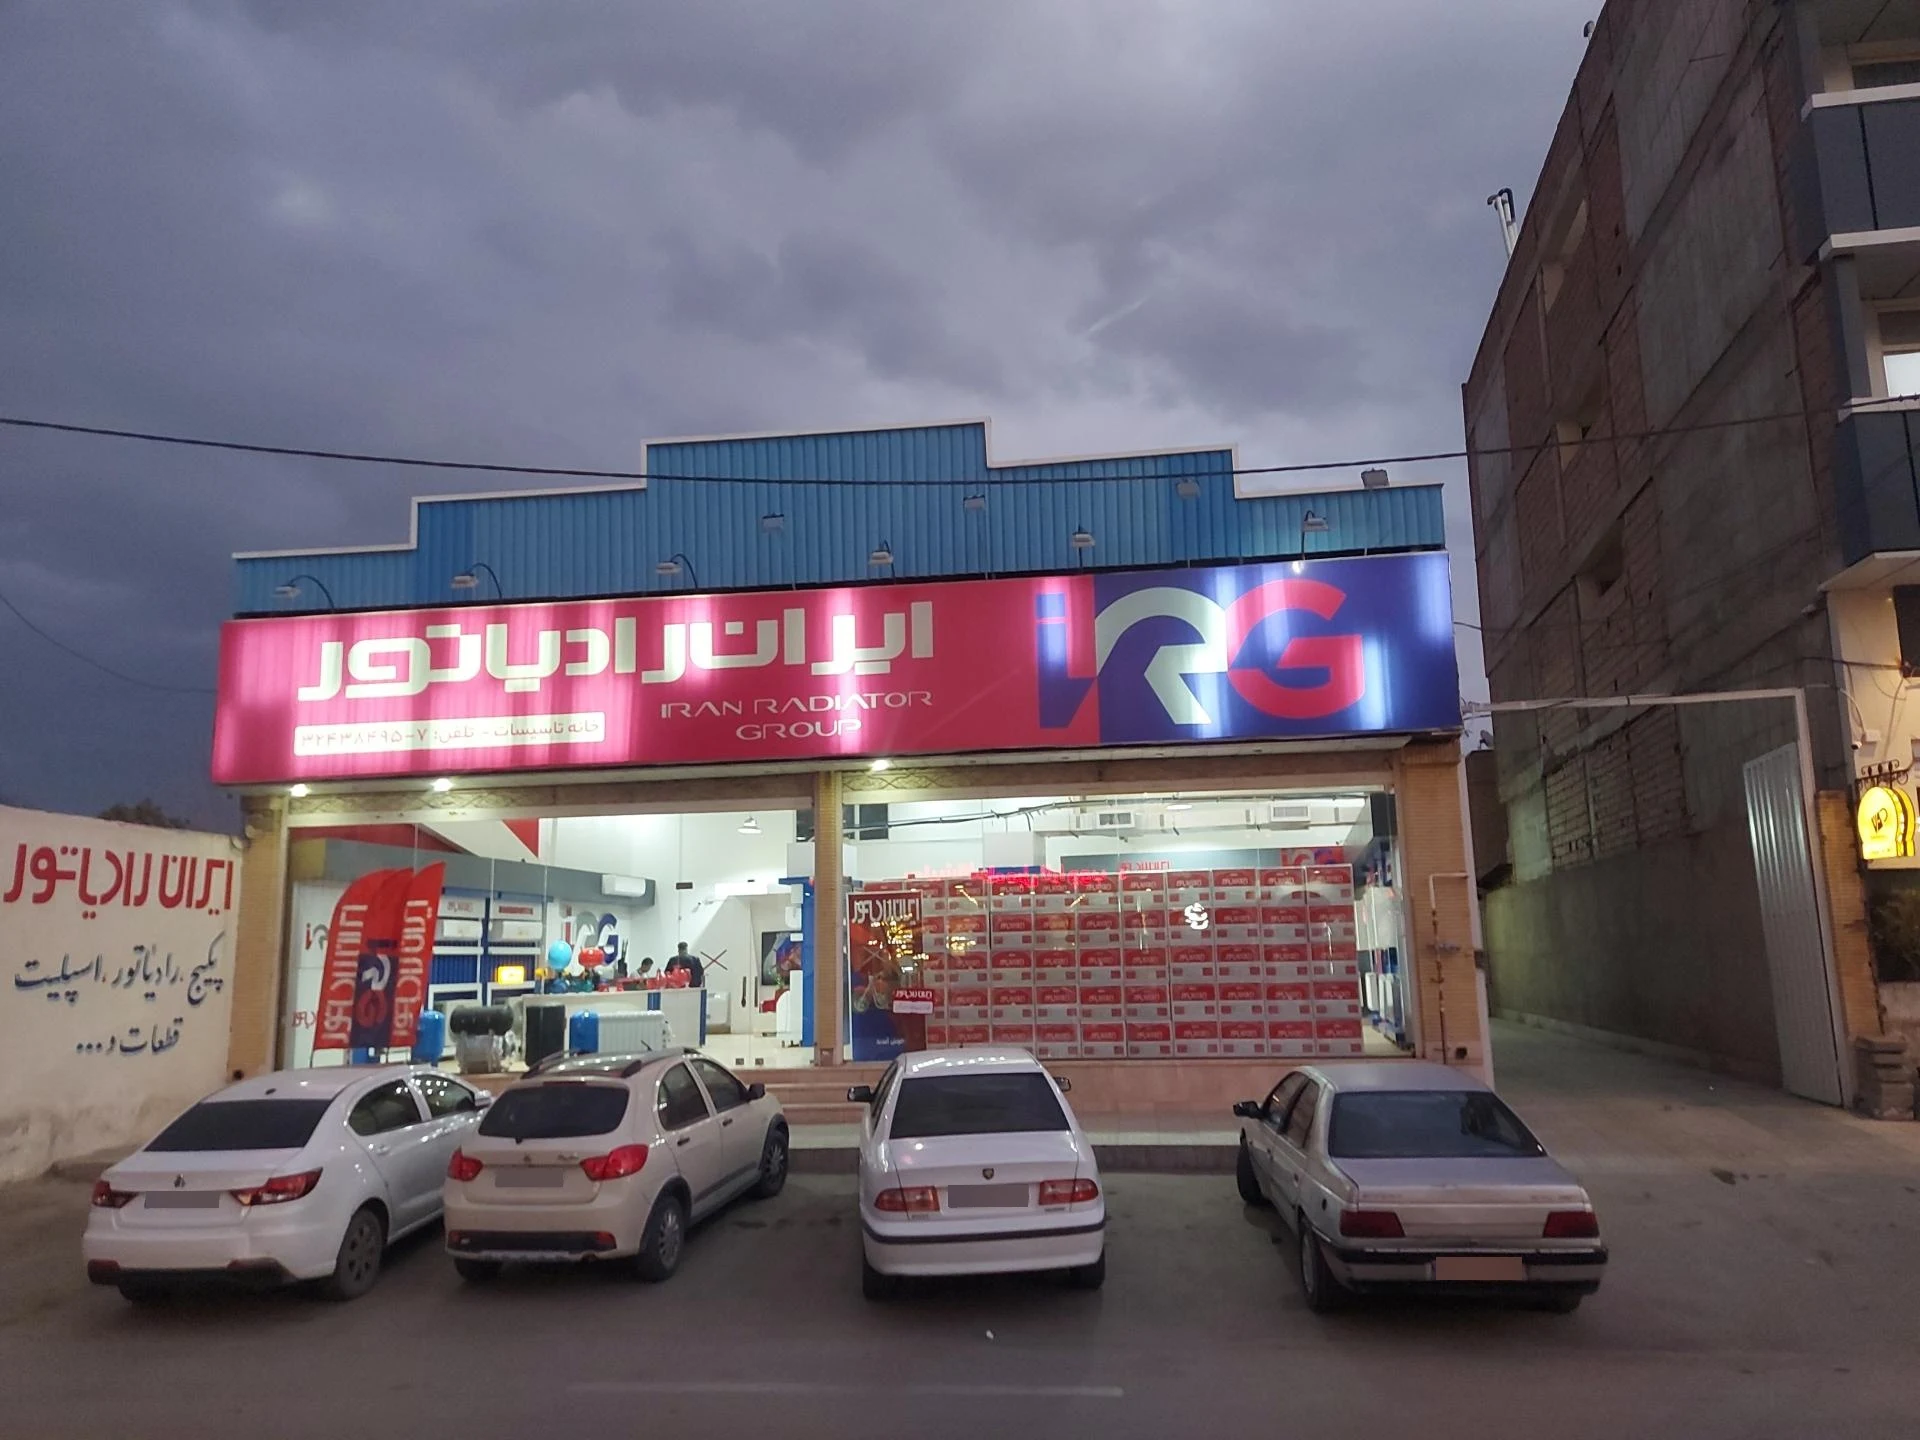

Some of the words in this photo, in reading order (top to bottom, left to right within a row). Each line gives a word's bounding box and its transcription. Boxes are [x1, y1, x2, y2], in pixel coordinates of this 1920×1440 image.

[687, 601, 934, 677] ایران
[297, 616, 687, 702] رادیاتور
[661, 700, 742, 719] IRAN
[754, 690, 933, 714] RADIATOR
[493, 722, 564, 739] تاسیسات
[567, 720, 600, 733] خانه
[735, 718, 862, 741] GROUP
[2, 843, 153, 920] رادیاتور
[157, 853, 234, 916] ایران
[119, 1017, 184, 1056] قطعات
